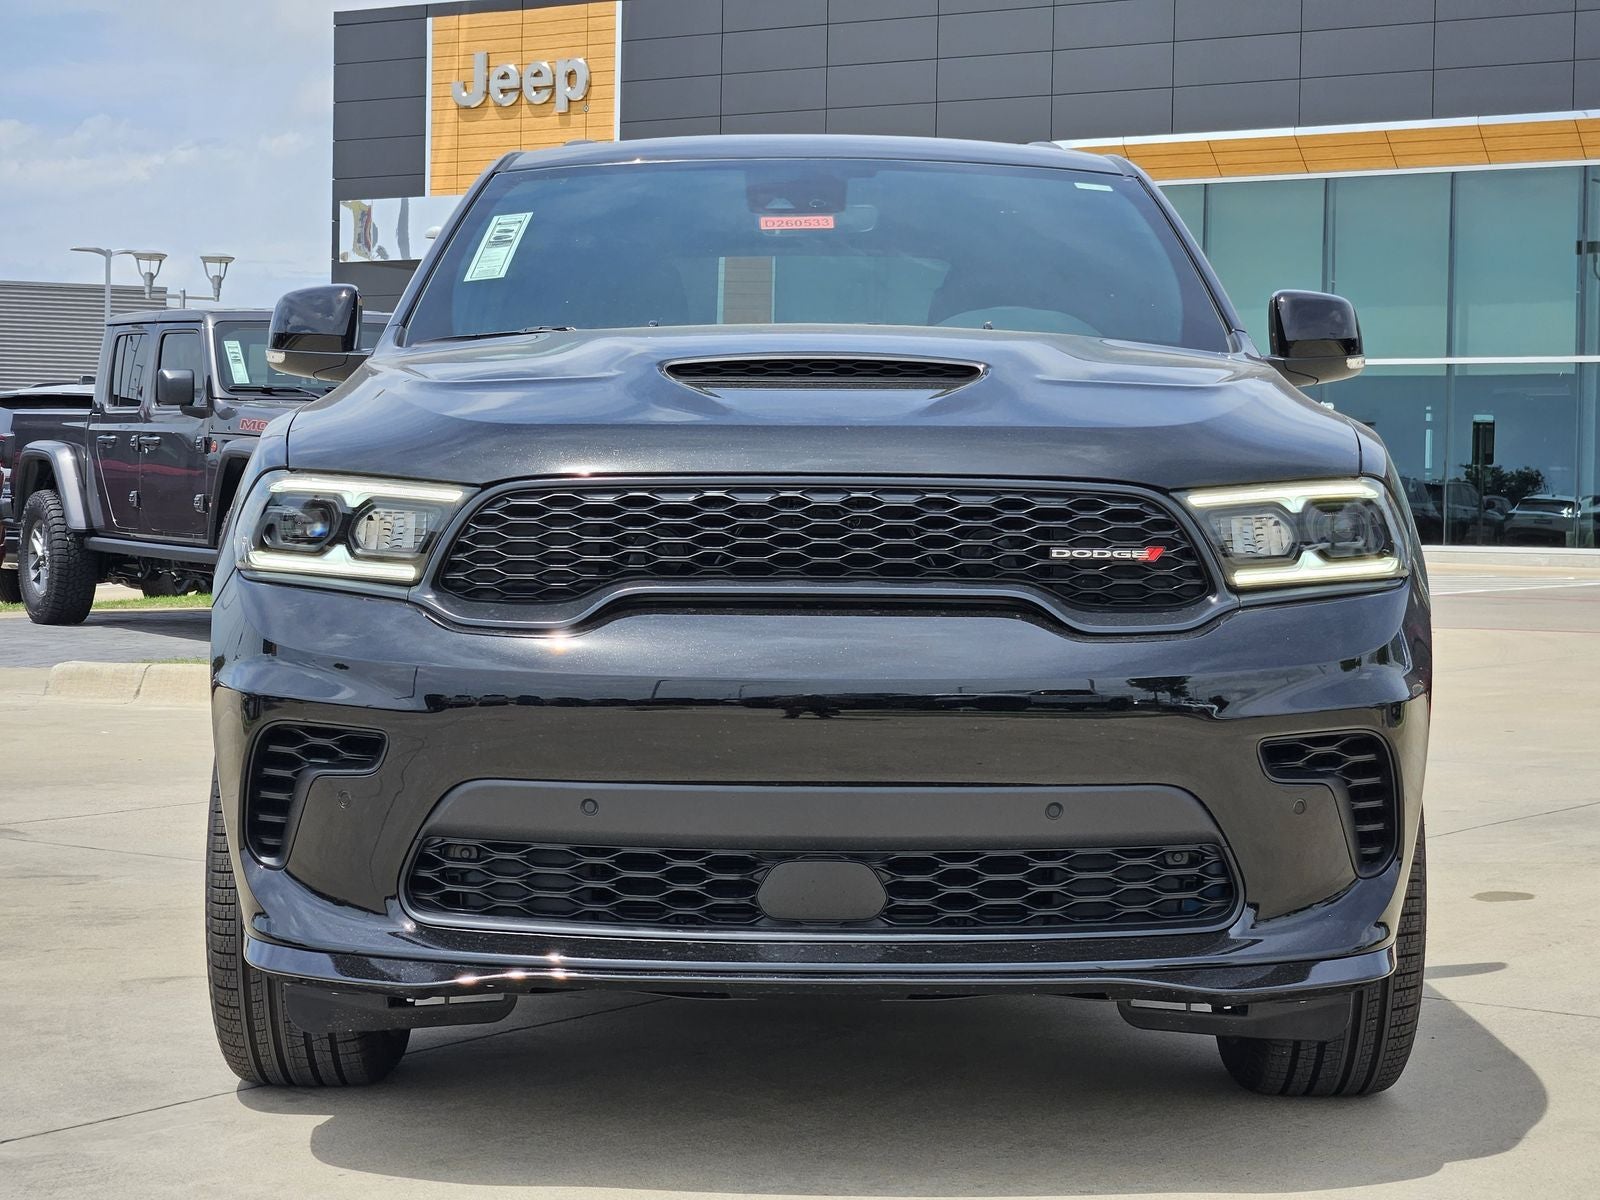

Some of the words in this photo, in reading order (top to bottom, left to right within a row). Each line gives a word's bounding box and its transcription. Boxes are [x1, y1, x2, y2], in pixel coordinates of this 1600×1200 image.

[452, 52, 590, 113] Jeep
[764, 218, 831, 228] D260533
[1051, 549, 1150, 559] DODGE
